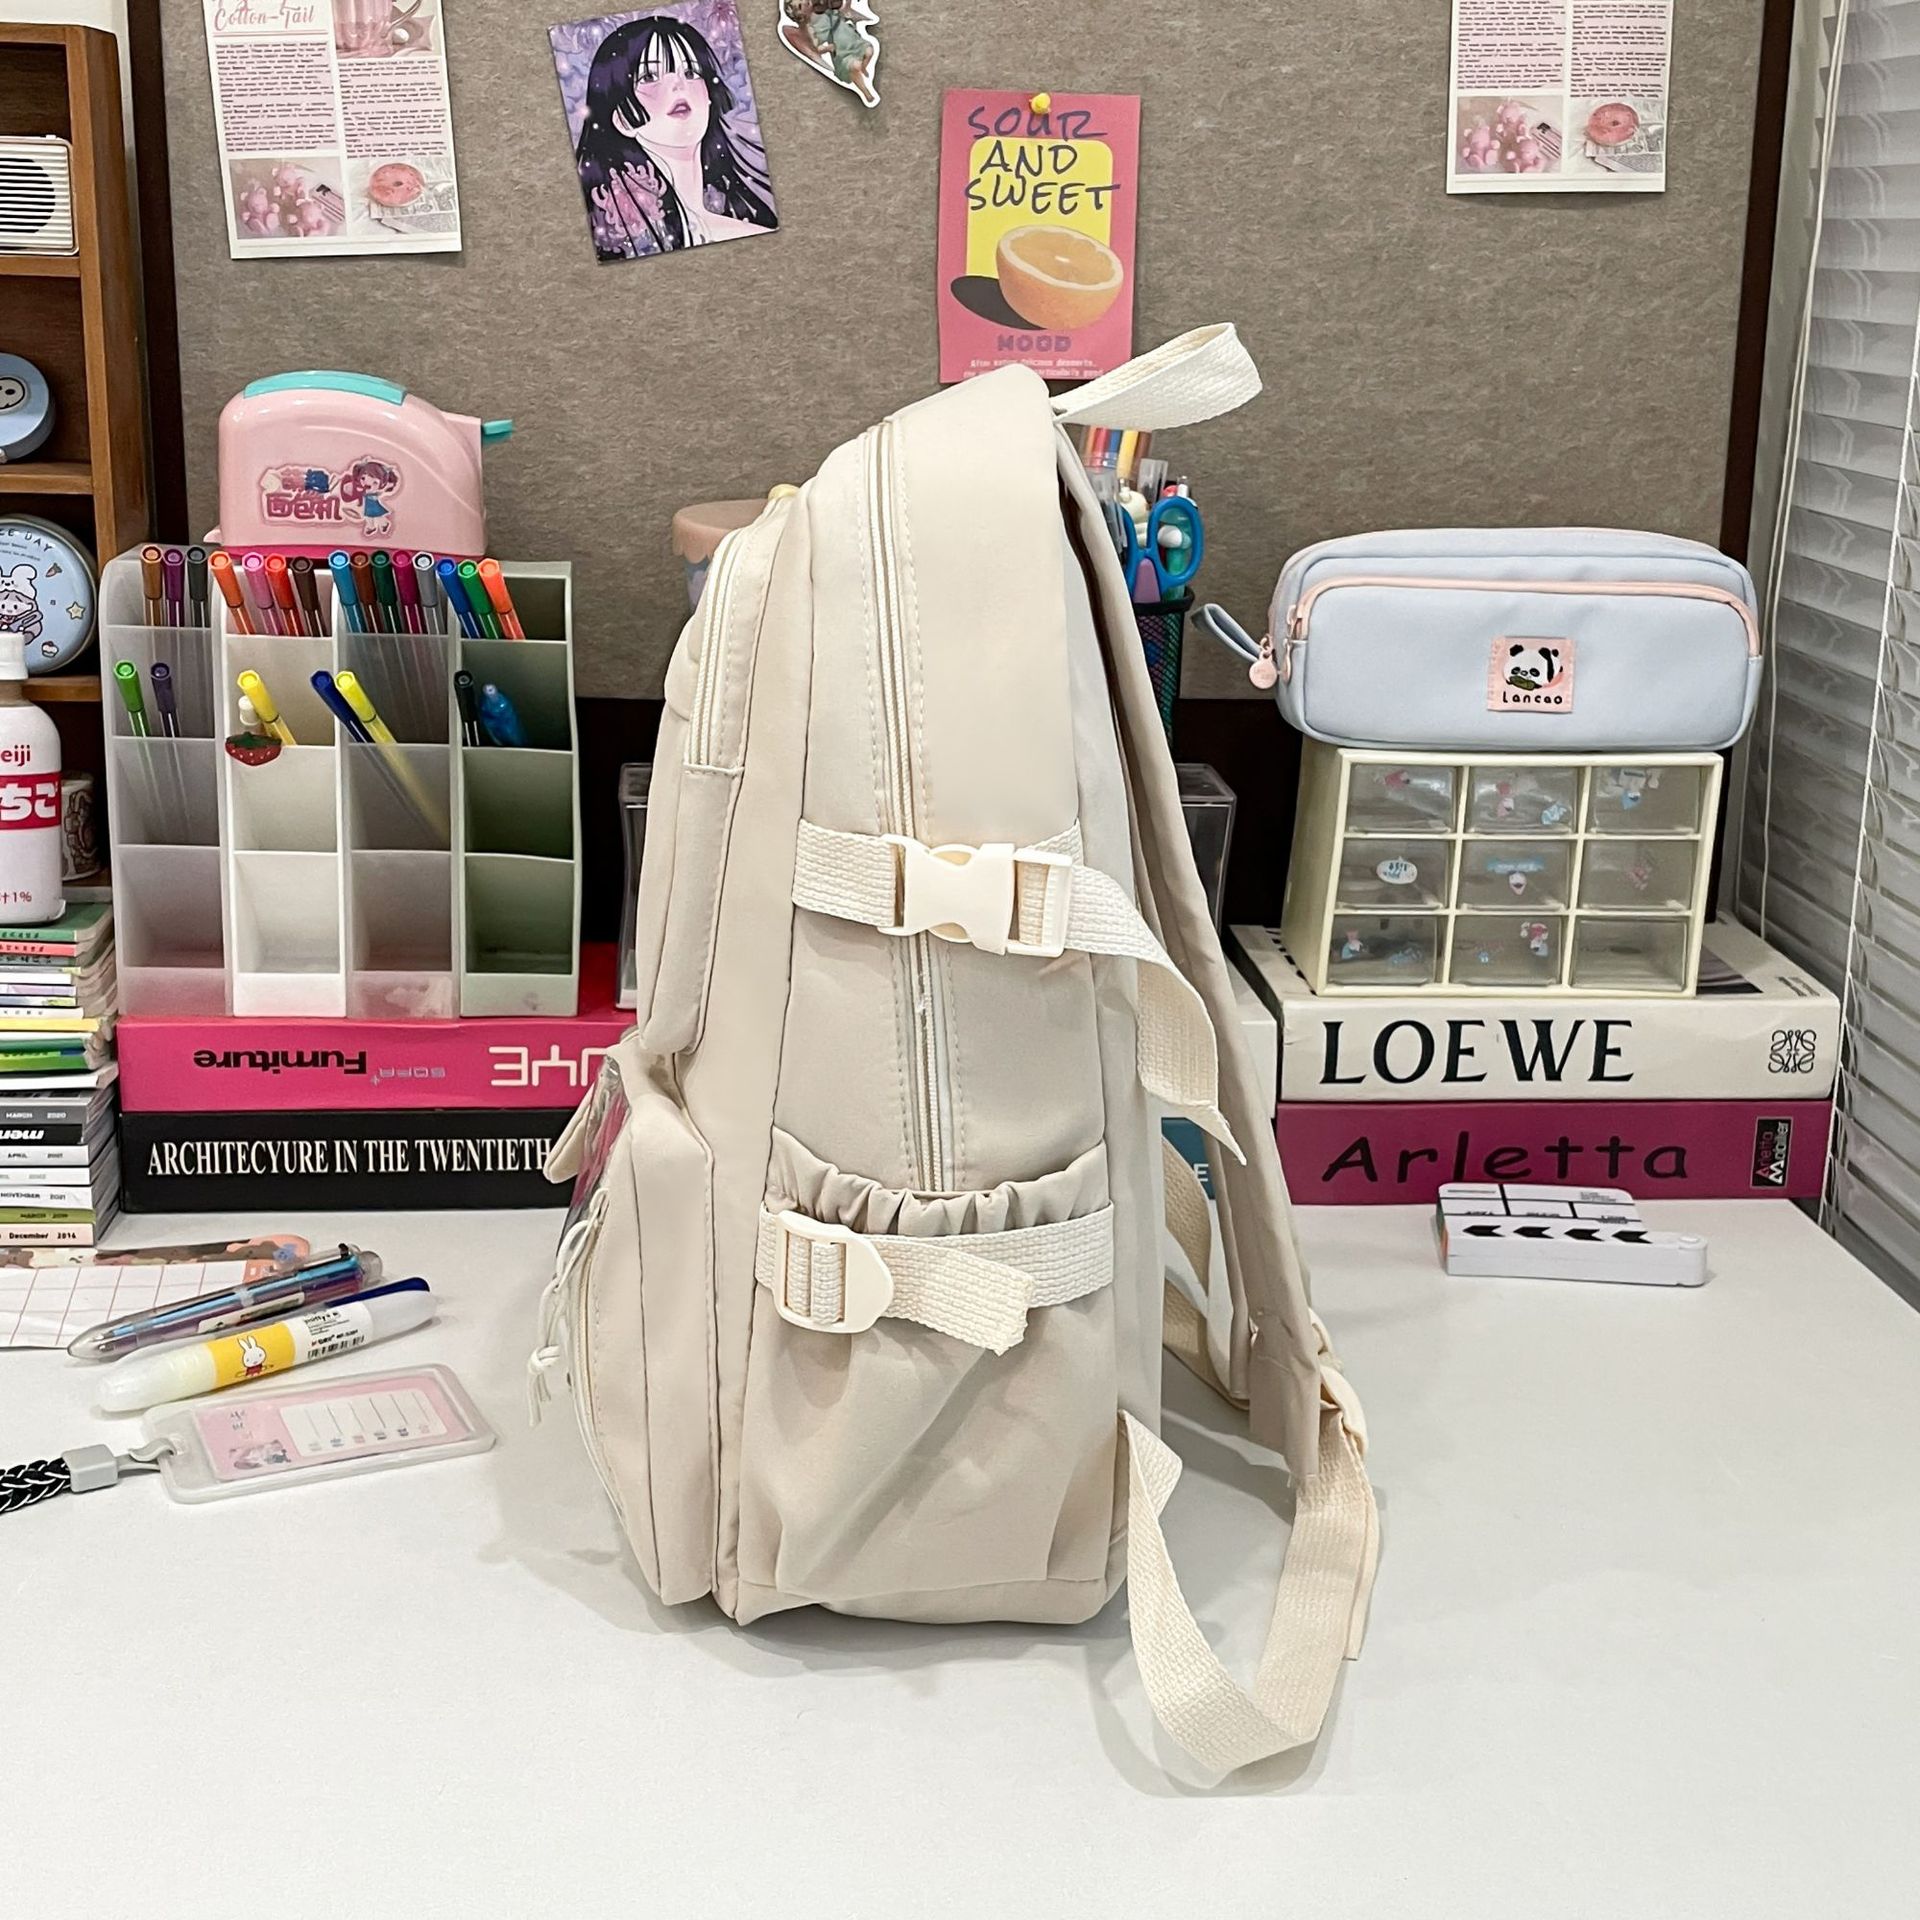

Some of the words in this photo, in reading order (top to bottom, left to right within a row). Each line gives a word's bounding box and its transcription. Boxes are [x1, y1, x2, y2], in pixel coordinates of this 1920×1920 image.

[968, 106, 1108, 141] SOUR
[979, 139, 1078, 179] AND
[964, 174, 1122, 215] SWEET
[997, 334, 1072, 352] MOOD
[1502, 690, 1564, 705] Lancao
[193, 1049, 367, 1075] Furniture
[1319, 1019, 1635, 1085] LOEWE
[147, 1140, 330, 1176] ARCHITECYURE
[334, 1139, 359, 1173] IN
[363, 1139, 410, 1173] THE
[414, 1137, 553, 1172] TWENTIETH
[1322, 1131, 1689, 1184] Arletta
[9, 1231, 48, 1240] December
